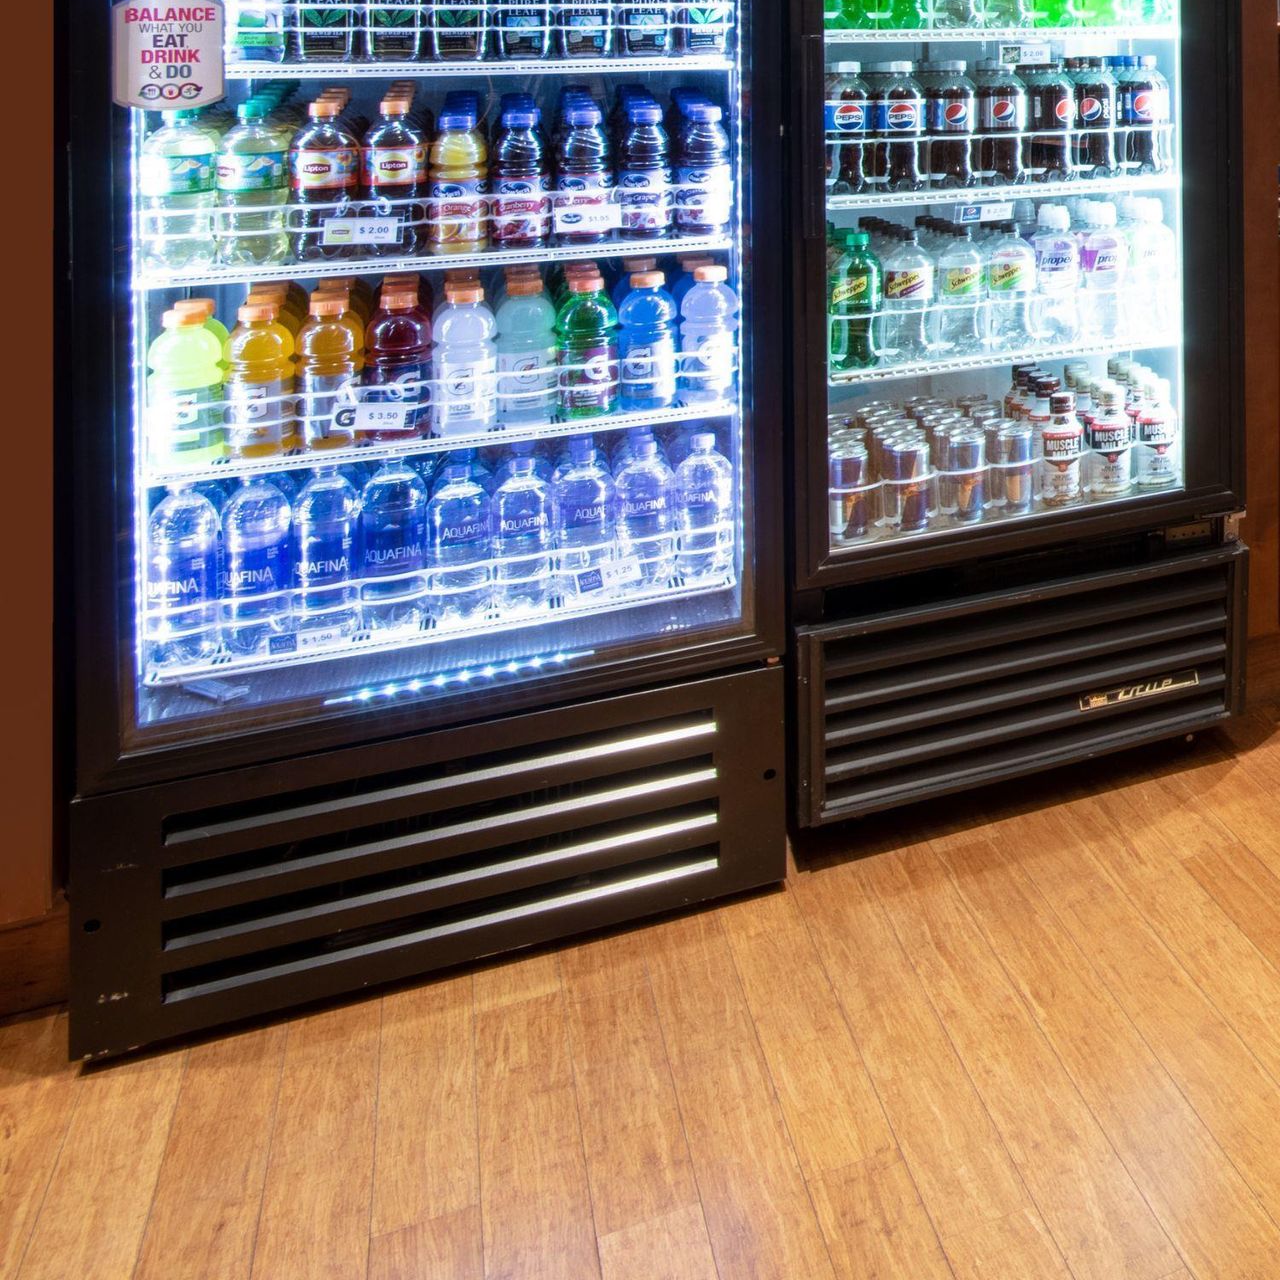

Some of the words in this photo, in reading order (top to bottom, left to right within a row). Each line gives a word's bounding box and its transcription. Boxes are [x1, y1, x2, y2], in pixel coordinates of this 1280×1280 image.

[125, 8, 215, 22] BALANCE
[139, 23, 175, 33] WHAT
[179, 23, 203, 33] YOU
[141, 50, 200, 63] DRINK
[149, 66, 162, 79] &
[166, 65, 192, 78] DO
[835, 114, 863, 122] PEPSI
[889, 113, 915, 121] PEPSI
[303, 165, 331, 173] Lipton
[381, 162, 407, 170] Lipton
[369, 226, 389, 234] 2.00
[992, 265, 1021, 285] Schweppes
[889, 273, 919, 292] Schweppes
[833, 281, 865, 299] Schweppes
[1095, 430, 1129, 442] MUSCLE
[1047, 438, 1080, 451] MUSCLE
[621, 498, 666, 515] AQUAFINA
[500, 515, 548, 531] AQUAFINA
[365, 543, 422, 563] AQUAFINA
[606, 569, 612, 578] $
[614, 565, 634, 577] 1.25
[302, 635, 309, 645] $
[312, 633, 332, 644] 1.50
